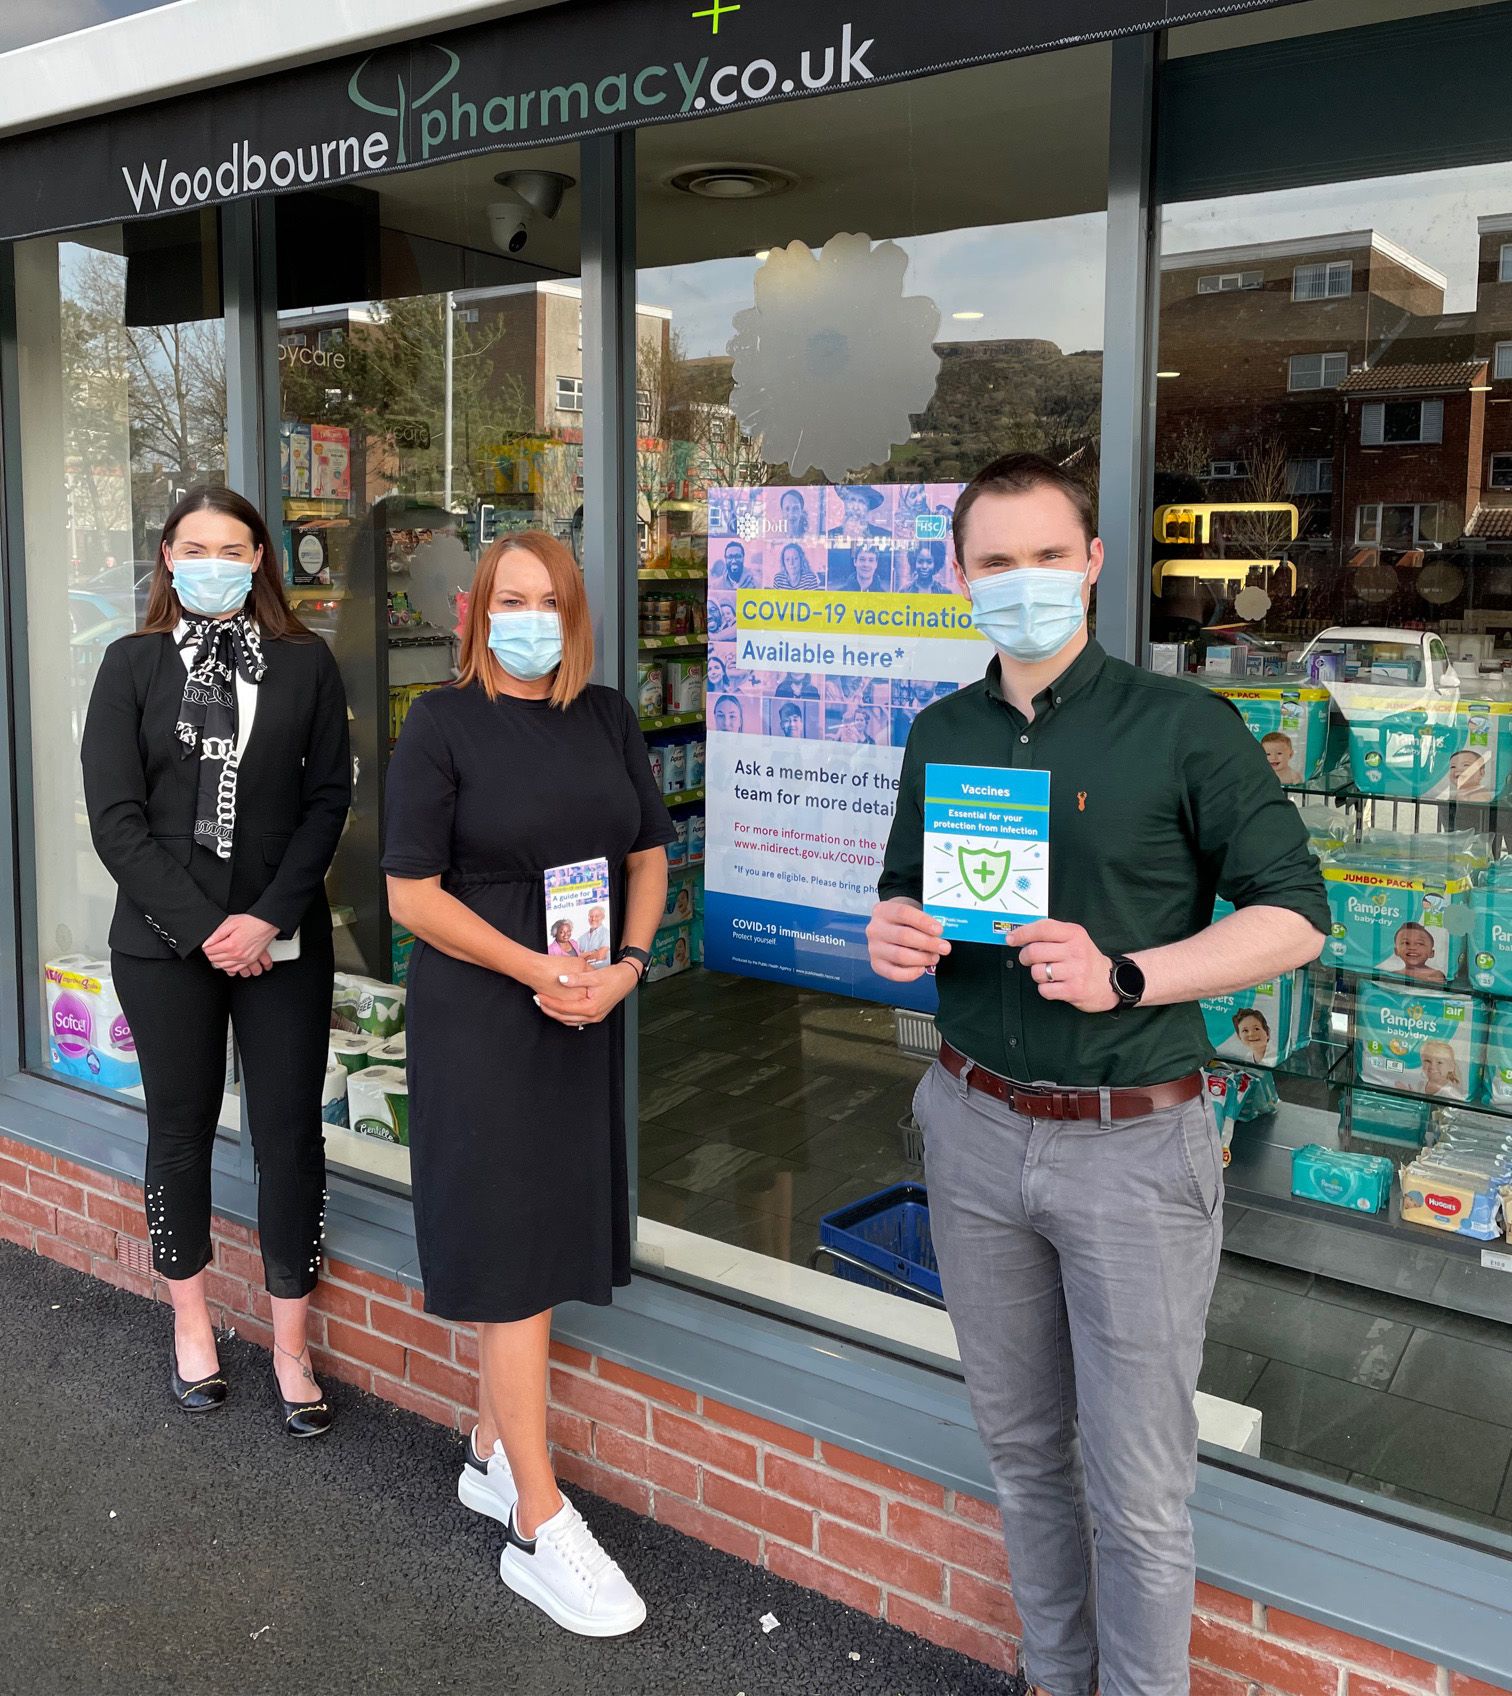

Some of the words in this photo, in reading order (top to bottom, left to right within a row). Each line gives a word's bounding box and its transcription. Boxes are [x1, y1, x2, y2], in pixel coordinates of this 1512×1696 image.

[121, 131, 389, 213] Woodbourne
[763, 519, 788, 534] DoH
[920, 522, 940, 531] HSC
[742, 600, 847, 624] COVID-19
[853, 604, 972, 630] vaccinatio
[742, 640, 835, 665] Available
[1237, 691, 1261, 699] PACK
[734, 759, 761, 776] Ask
[766, 766, 774, 778] a
[779, 767, 847, 785] member
[851, 772, 869, 787] of
[873, 773, 901, 790] the
[961, 783, 1011, 797] Vaccines
[734, 785, 772, 803] team
[777, 789, 800, 805] for
[805, 795, 847, 811] more
[852, 797, 894, 817] detai
[948, 809, 987, 820] Essential
[988, 812, 1001, 820] for
[1003, 814, 1023, 823] your
[933, 820, 977, 831] protection
[978, 823, 998, 833] from
[1000, 825, 1039, 836] infection
[734, 822, 750, 832] For
[753, 826, 779, 837] more
[781, 827, 840, 845] information
[843, 838, 856, 848] on
[859, 839, 877, 850] the
[745, 866, 760, 877] you
[761, 869, 775, 879] are
[776, 870, 808, 884] eligible.
[811, 875, 837, 888] Please
[839, 880, 861, 894] bring
[863, 883, 879, 895] pho
[1343, 873, 1384, 886] JUMBO+
[1386, 878, 1414, 889] PACK
[559, 893, 579, 902] guide
[552, 902, 574, 910] adults
[1348, 896, 1401, 918] Pampers
[1354, 913, 1393, 927] baby-dry
[732, 918, 777, 935] COVID-19
[779, 925, 846, 947] immunisation
[732, 931, 753, 942] Protect
[1332, 924, 1345, 935] 5+
[1479, 953, 1493, 965] 5+
[45, 967, 64, 984] NEW
[1445, 1006, 1464, 1017] air
[1379, 1007, 1438, 1033] Pampers
[113, 1025, 131, 1036] So
[1371, 1040, 1379, 1050] 8
